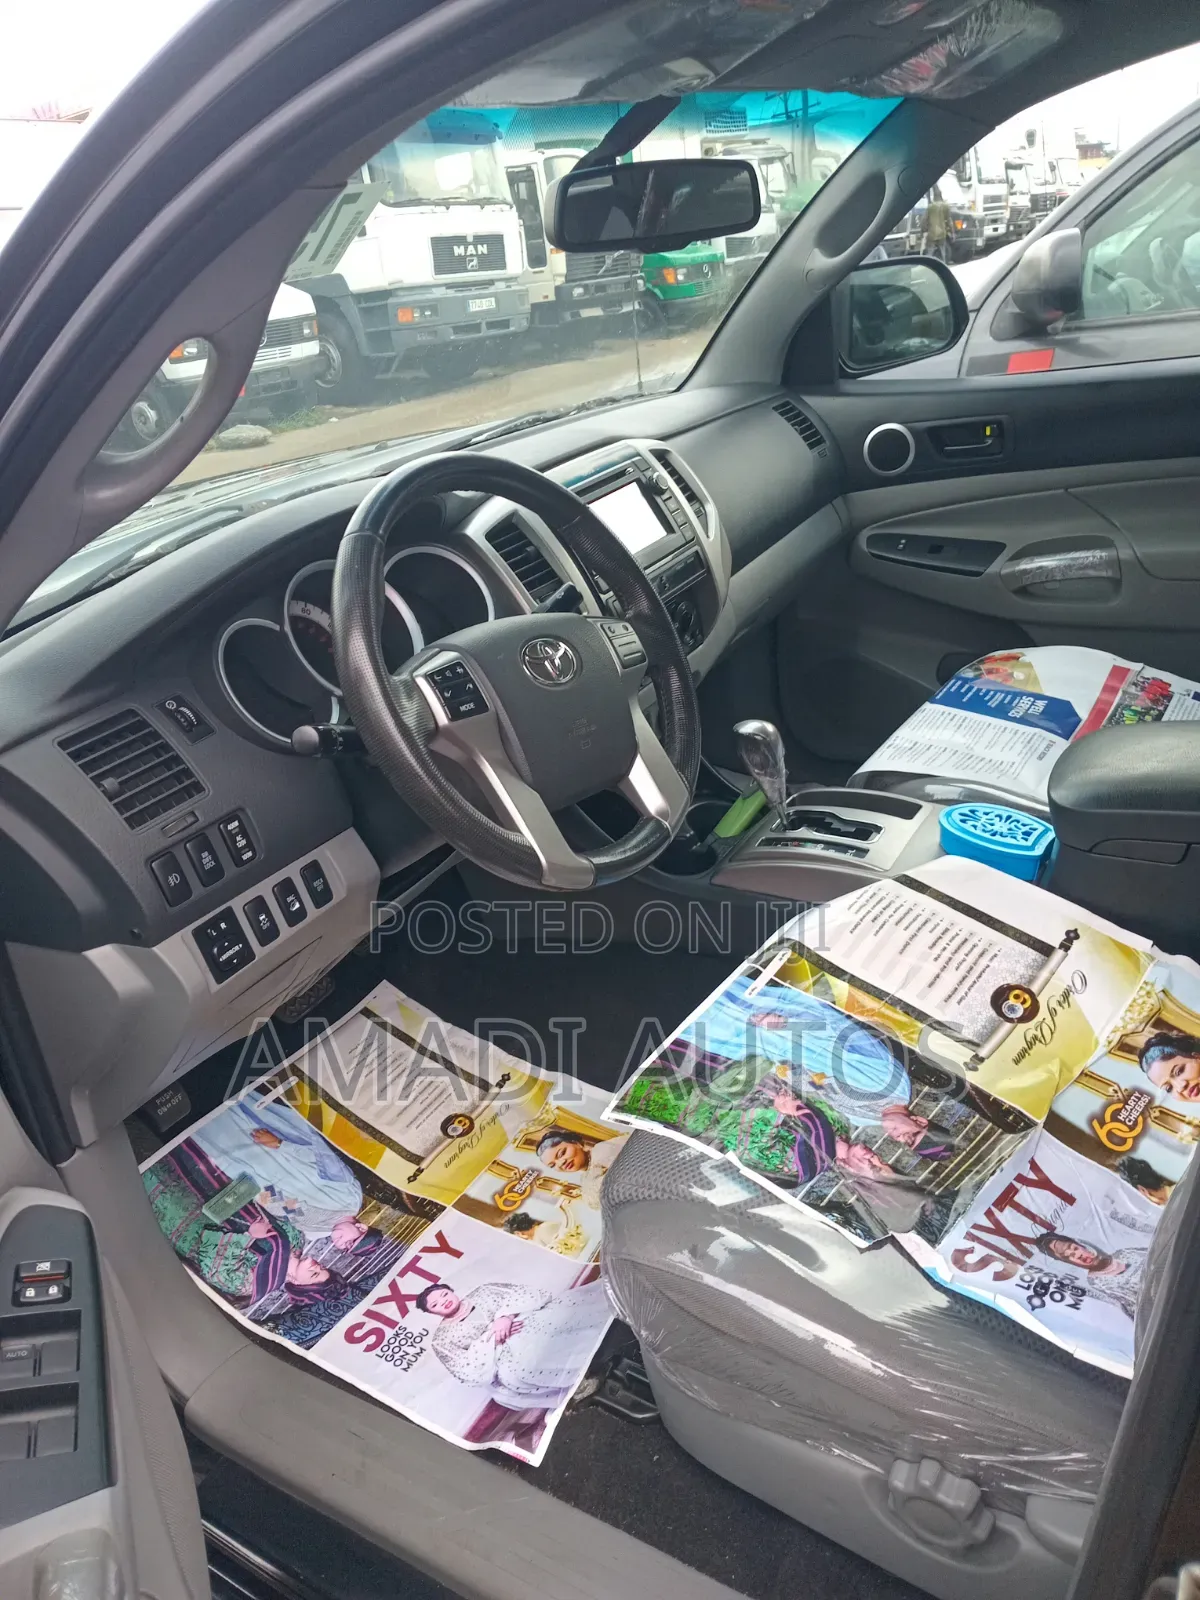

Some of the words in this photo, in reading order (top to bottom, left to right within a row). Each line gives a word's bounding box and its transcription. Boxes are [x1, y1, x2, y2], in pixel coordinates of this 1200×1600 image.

[453, 244, 488, 256] MAN
[459, 702, 475, 713] MODE
[1032, 699, 1048, 715] WELL
[204, 861, 216, 870] LOCK
[220, 922, 227, 930] R
[221, 946, 240, 960] MIRROR
[963, 941, 978, 957] Opening
[1056, 970, 1087, 1009] Order
[1047, 995, 1058, 1032] of
[1012, 1017, 1054, 1066] Program
[155, 1090, 173, 1105] PUSH
[157, 1105, 168, 1115] ON
[171, 1093, 182, 1104] OFF
[1117, 1091, 1141, 1121] HEARTY
[1125, 1094, 1151, 1125] CHEERS!
[1092, 1103, 1143, 1151] 60
[951, 1157, 1077, 1282] SIXTY
[344, 1230, 464, 1352] SIXTY
[6, 1350, 27, 1358] AUTO
[375, 1326, 407, 1359] LOOKS
[384, 1331, 414, 1362] GOOD
[393, 1351, 411, 1367] ON
[407, 1328, 429, 1349] YOU
[401, 1347, 427, 1372] MUM
